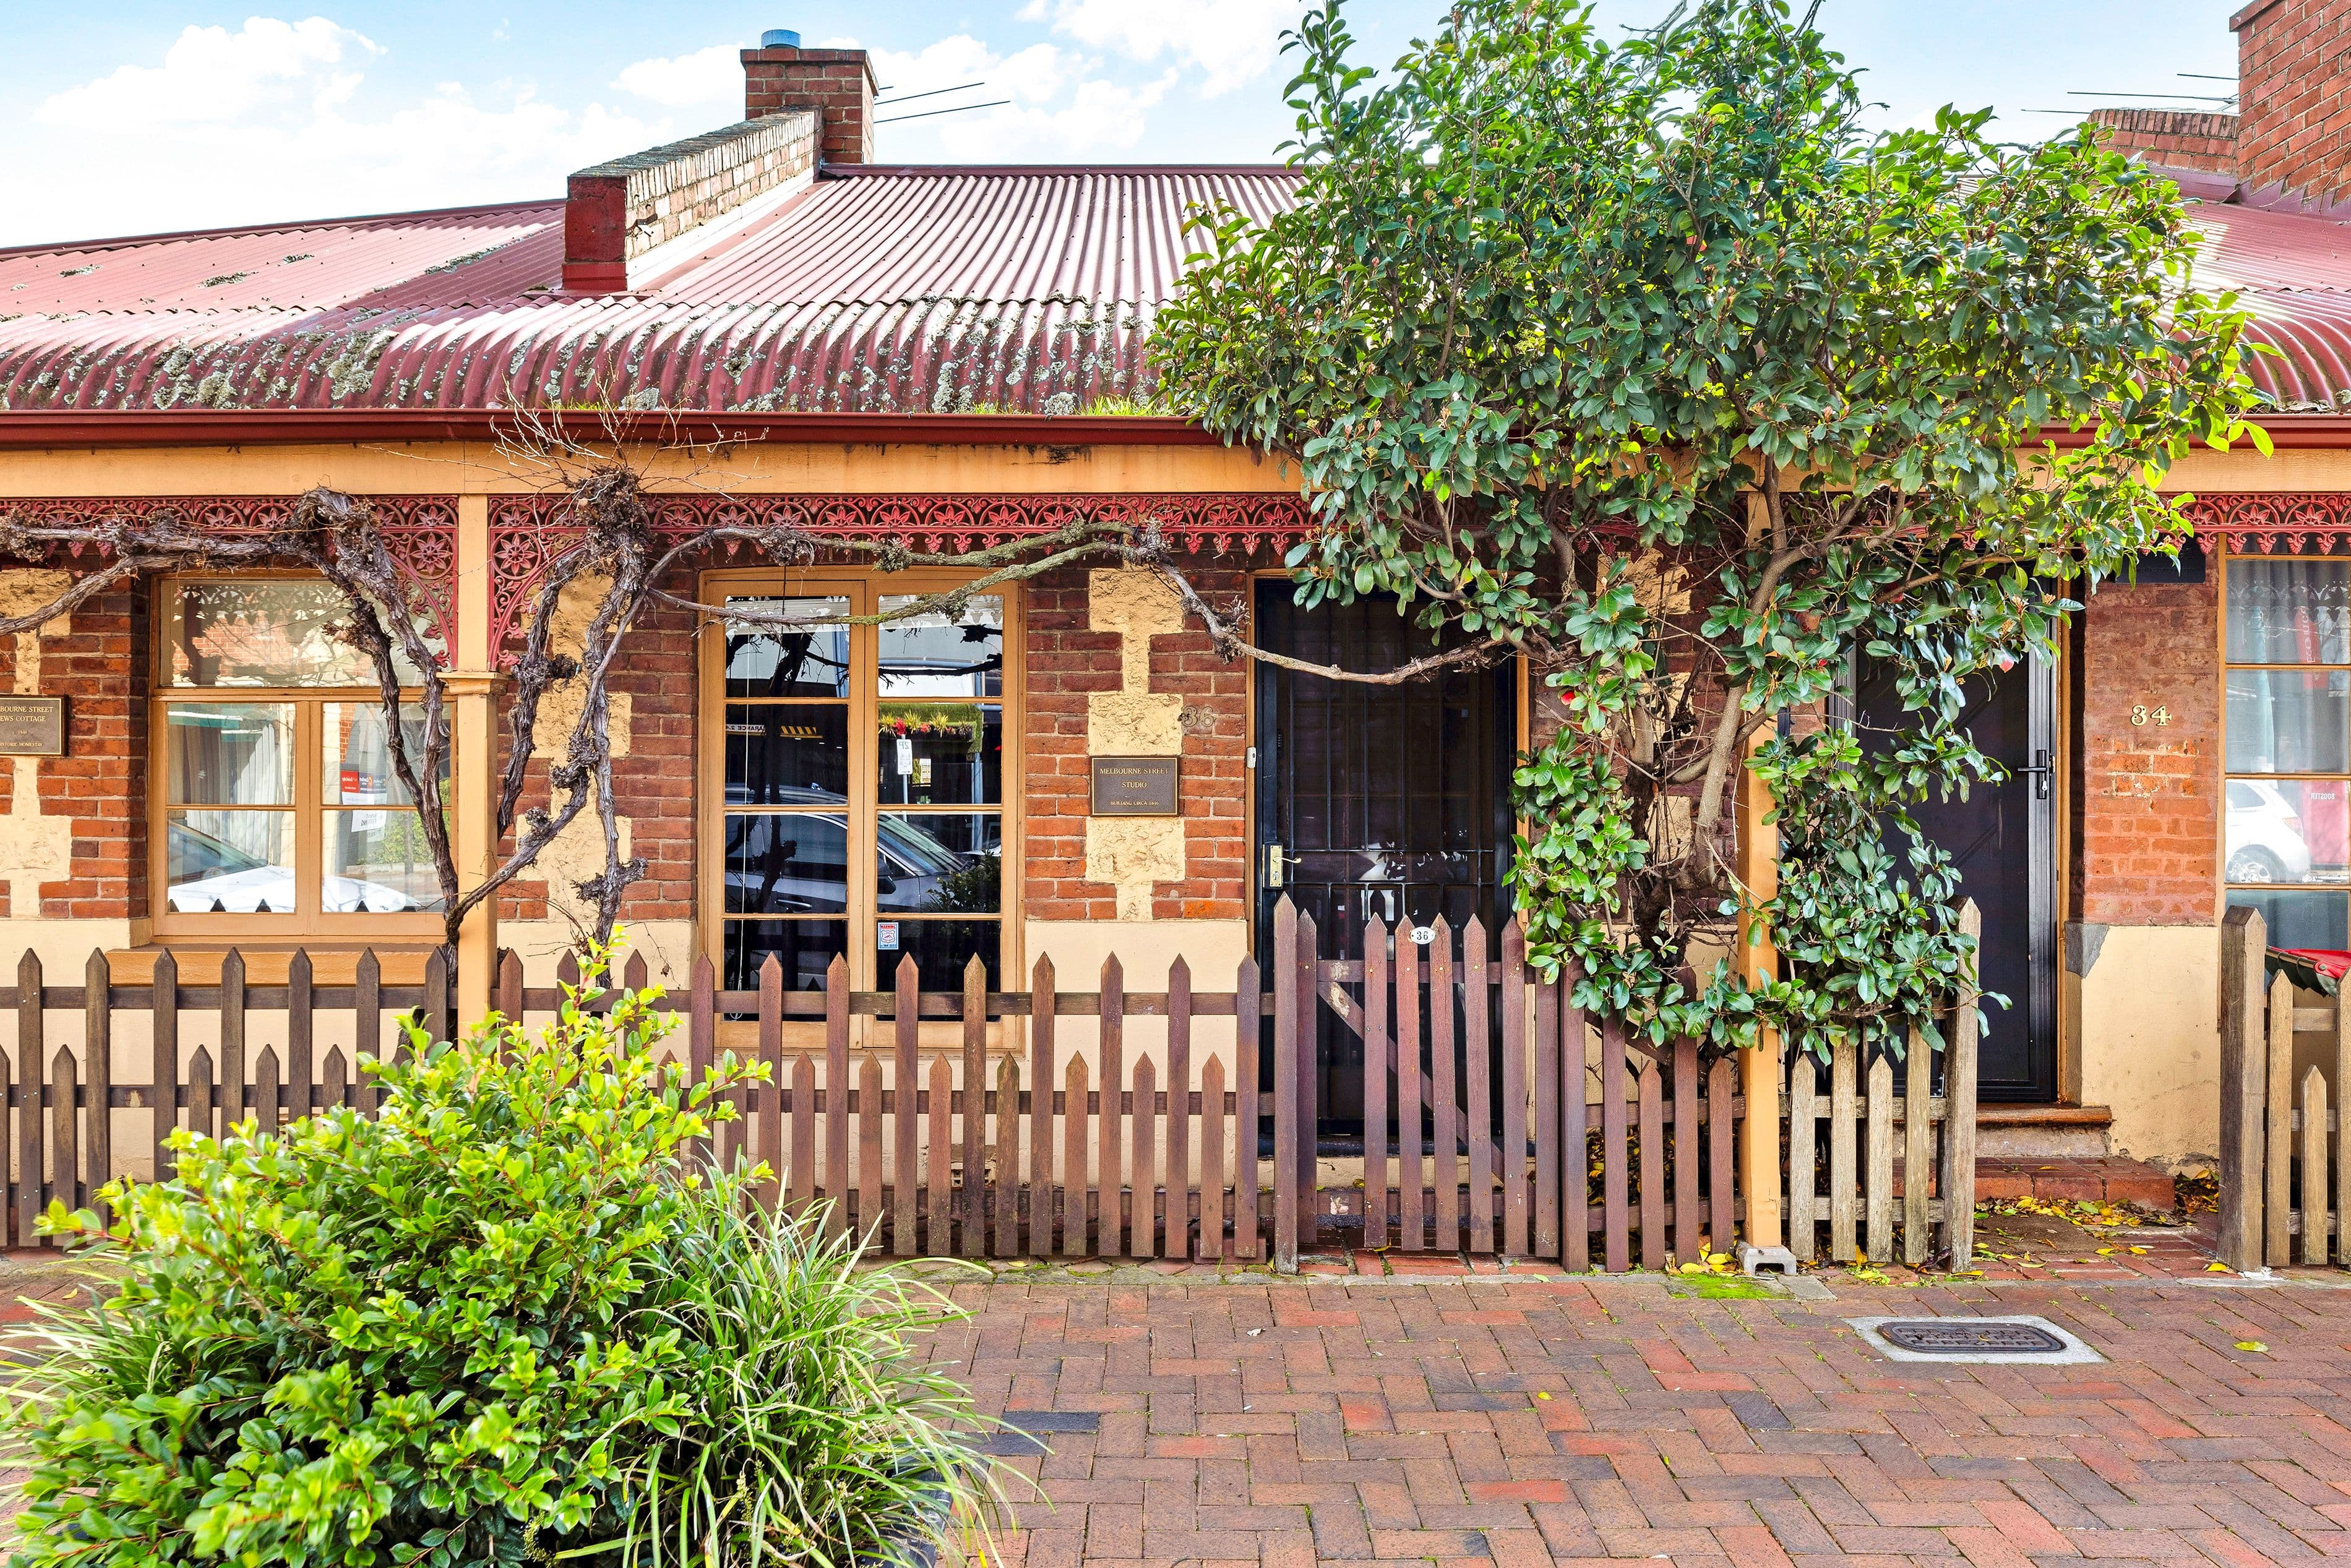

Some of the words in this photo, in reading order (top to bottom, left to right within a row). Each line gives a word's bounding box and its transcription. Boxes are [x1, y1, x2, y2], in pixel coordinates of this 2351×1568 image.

[1181, 706, 1213, 727] 36
[2130, 705, 2172, 726] 34
[1417, 931, 1429, 940] 36
